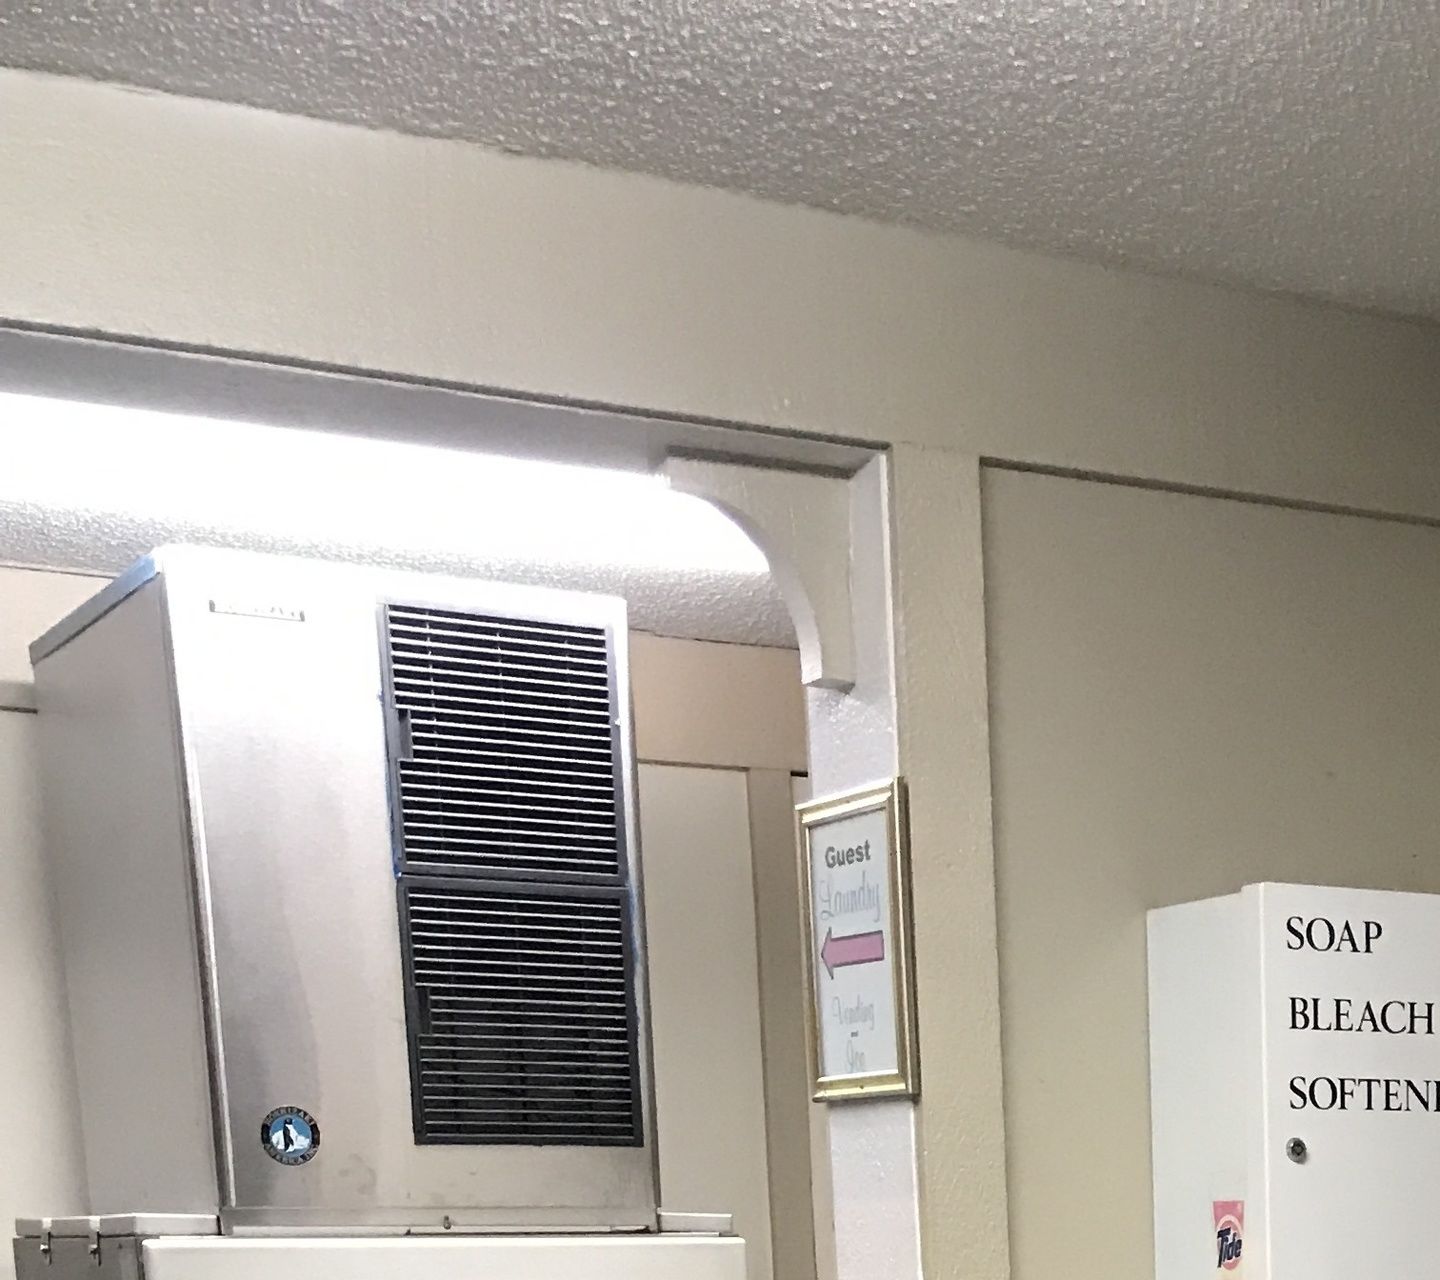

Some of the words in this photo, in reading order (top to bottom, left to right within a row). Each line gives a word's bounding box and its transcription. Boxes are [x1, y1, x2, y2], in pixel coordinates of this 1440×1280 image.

[824, 839, 871, 869] Guest
[1286, 916, 1383, 953] SOAP
[1288, 996, 1435, 1035] BLEACH
[1217, 1226, 1242, 1268] Tide
